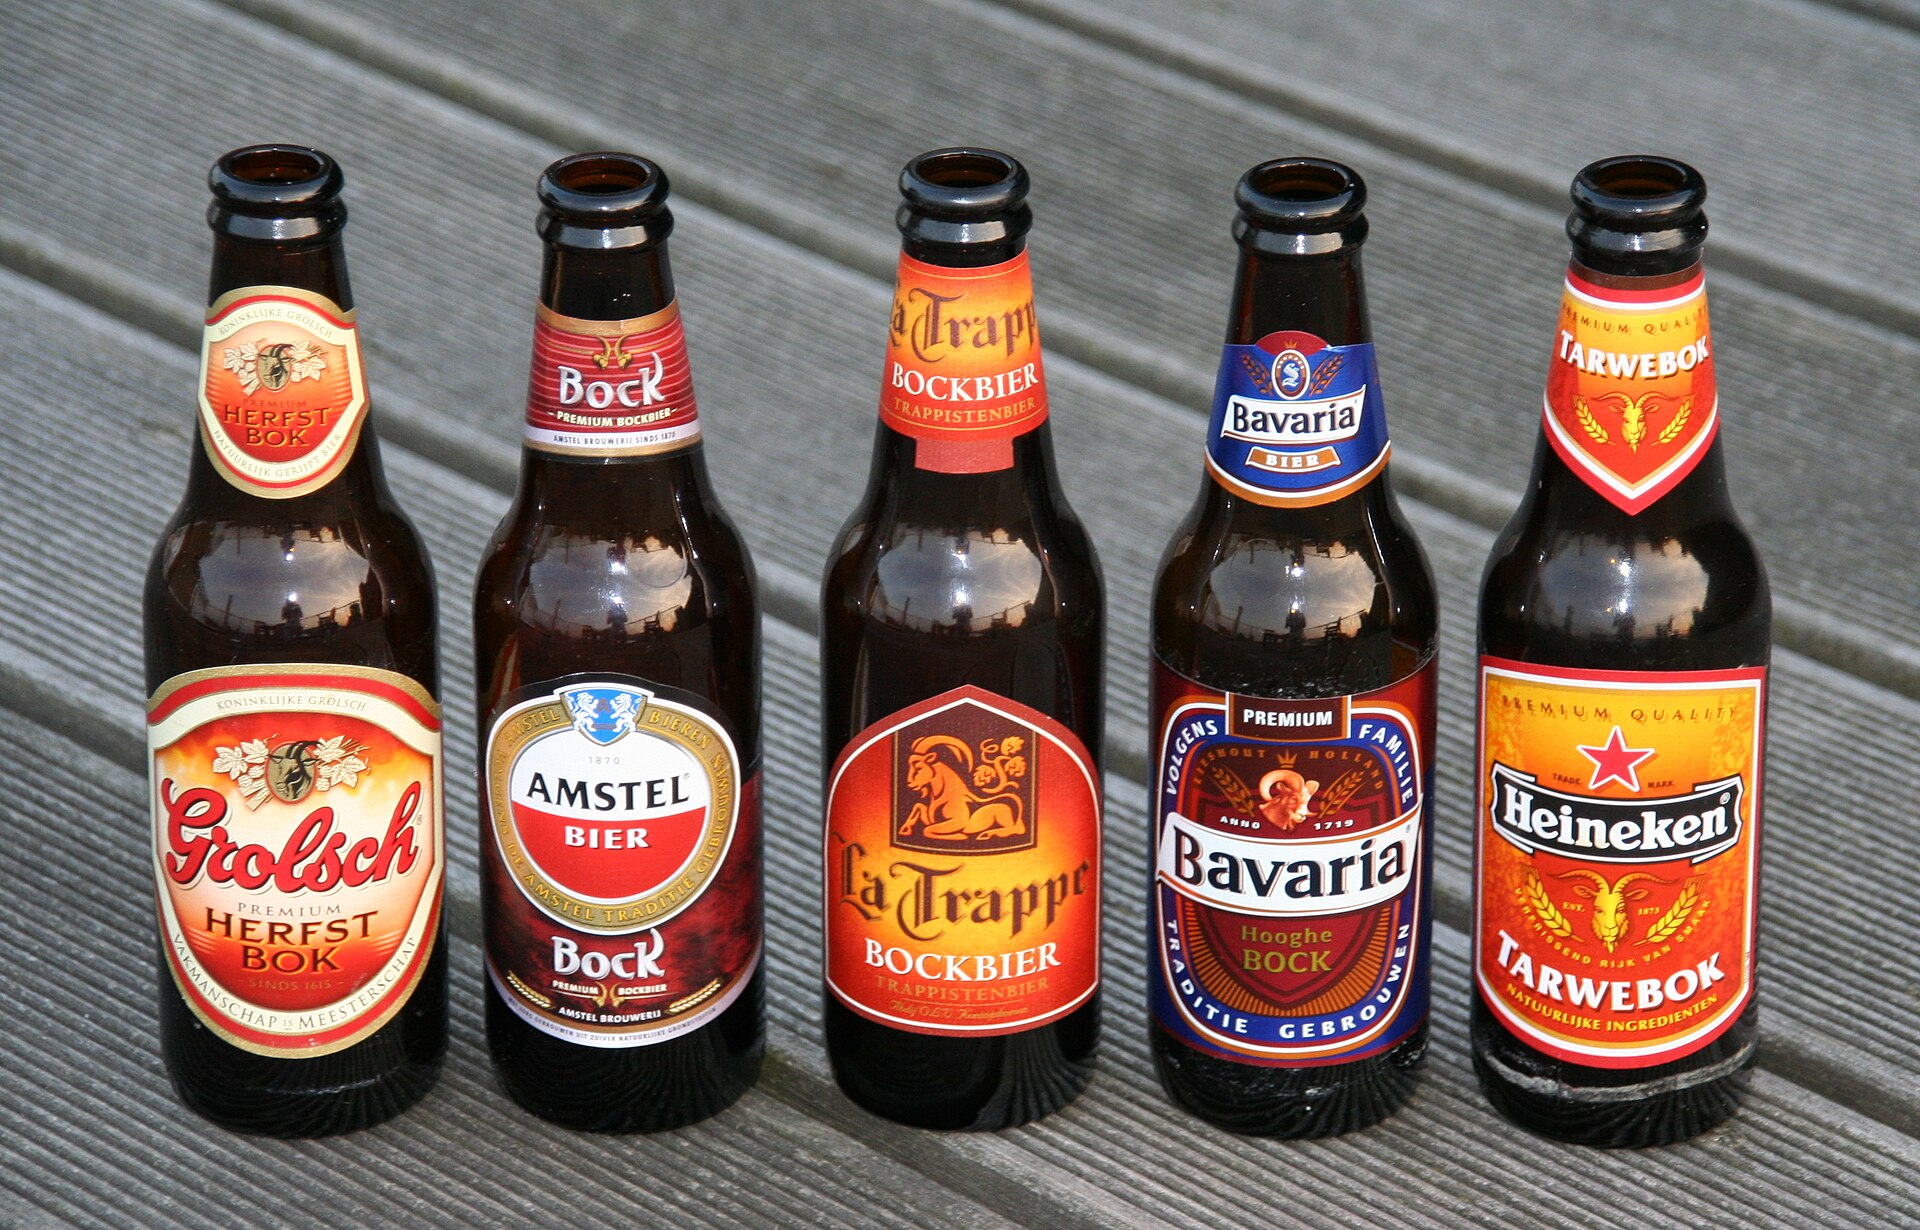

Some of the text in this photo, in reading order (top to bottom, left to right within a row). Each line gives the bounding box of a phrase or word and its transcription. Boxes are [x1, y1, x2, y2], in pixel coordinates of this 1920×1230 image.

[219, 308, 334, 338] KONINKLIJKE GROLSCH
[1559, 329, 1709, 379] TARWEBOK
[891, 361, 1039, 402] BOCKBIER
[224, 404, 331, 429] HERFST
[243, 398, 308, 408] PREMIUM
[556, 407, 672, 428] PREMIUM BOCKBIER
[894, 397, 1037, 424] TRAPPISTENBIER
[1232, 401, 1356, 434] Bavaria
[213, 430, 341, 477] NATUURLIJK GERIJPT BIER
[246, 429, 309, 448] BOK
[553, 434, 581, 445] AMSTEL
[584, 436, 632, 446] BROUWERIJ
[635, 434, 659, 444] SINDS
[1265, 453, 1320, 469] BIER
[215, 695, 367, 712] KONINKLIJKE GROLSCH
[1243, 708, 1334, 728] PREMIUM
[1501, 694, 1738, 725] PREMIUM QUALITY
[504, 707, 711, 750] AMSTEL BIEREN
[588, 755, 620, 766] 1870
[1165, 719, 1218, 797] VOLGENS
[1309, 750, 1384, 790] HOLLAND
[1358, 723, 1414, 805] FAMILIE
[526, 771, 691, 812] AMSTEL
[1552, 772, 1582, 786] TRADE
[1219, 815, 1355, 831] ANNO 1719
[1503, 783, 1729, 851] Heineken
[161, 777, 421, 893] Grolsch
[564, 825, 650, 851] BIER
[1173, 824, 1409, 899] Bavaria
[524, 873, 594, 921] AMSTEL
[603, 876, 696, 923] TRADITIE
[832, 831, 1091, 942] La Trappe
[237, 901, 342, 918] PREMIUM
[205, 907, 379, 946] HERFST
[1240, 924, 1333, 949] Hooghe
[1514, 887, 1711, 969] VERFRISSEND RIJK VAN SMAAK
[241, 945, 342, 974] BOK
[864, 937, 1062, 983] BOCKBIER
[1242, 948, 1333, 974] BOCK
[1497, 928, 1727, 1012] TARWEBOK
[173, 933, 278, 1029] VAKMANSCHAP
[299, 936, 416, 1030] MEESTERSCHAP
[249, 977, 299, 991] SINDS
[552, 980, 668, 997] PREMIUM BOCKBIER
[875, 974, 1049, 1002] TRAPPISTENBIER
[1166, 918, 1411, 1040] TRADITIE GEBROUWEN
[558, 1006, 662, 1024] AMSTEL BROUWERIJ
[1505, 982, 1719, 1032] NATUURLIJKE INGREDIENTEN
